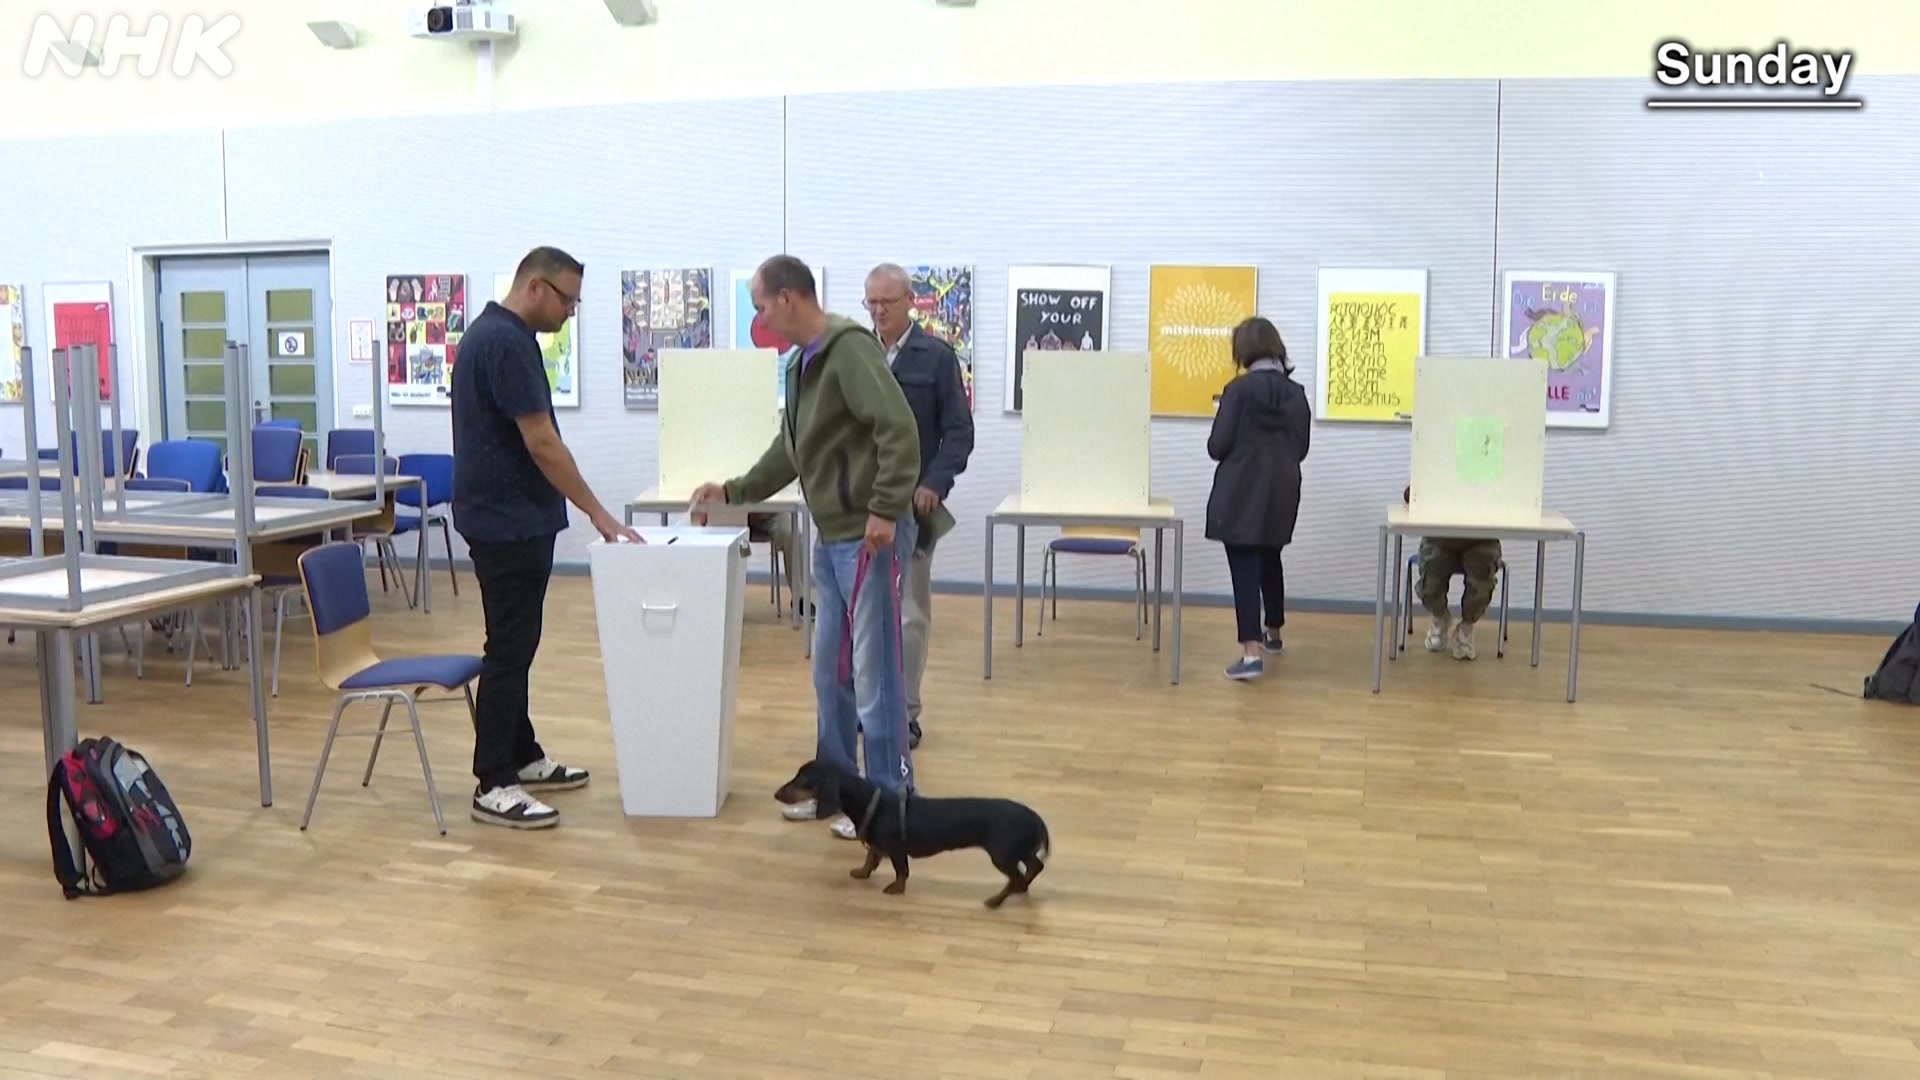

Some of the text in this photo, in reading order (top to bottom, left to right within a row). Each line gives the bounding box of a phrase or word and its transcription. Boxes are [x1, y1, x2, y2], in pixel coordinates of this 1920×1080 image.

[1020, 292, 1098, 311] SHOW OFF
[1512, 290, 1536, 307] Die
[1542, 284, 1577, 303] Erde
[1040, 311, 1082, 325] YOUR
[1329, 367, 1387, 380] racisme
[1329, 380, 1378, 394] racism
[1548, 386, 1570, 400] LLE
